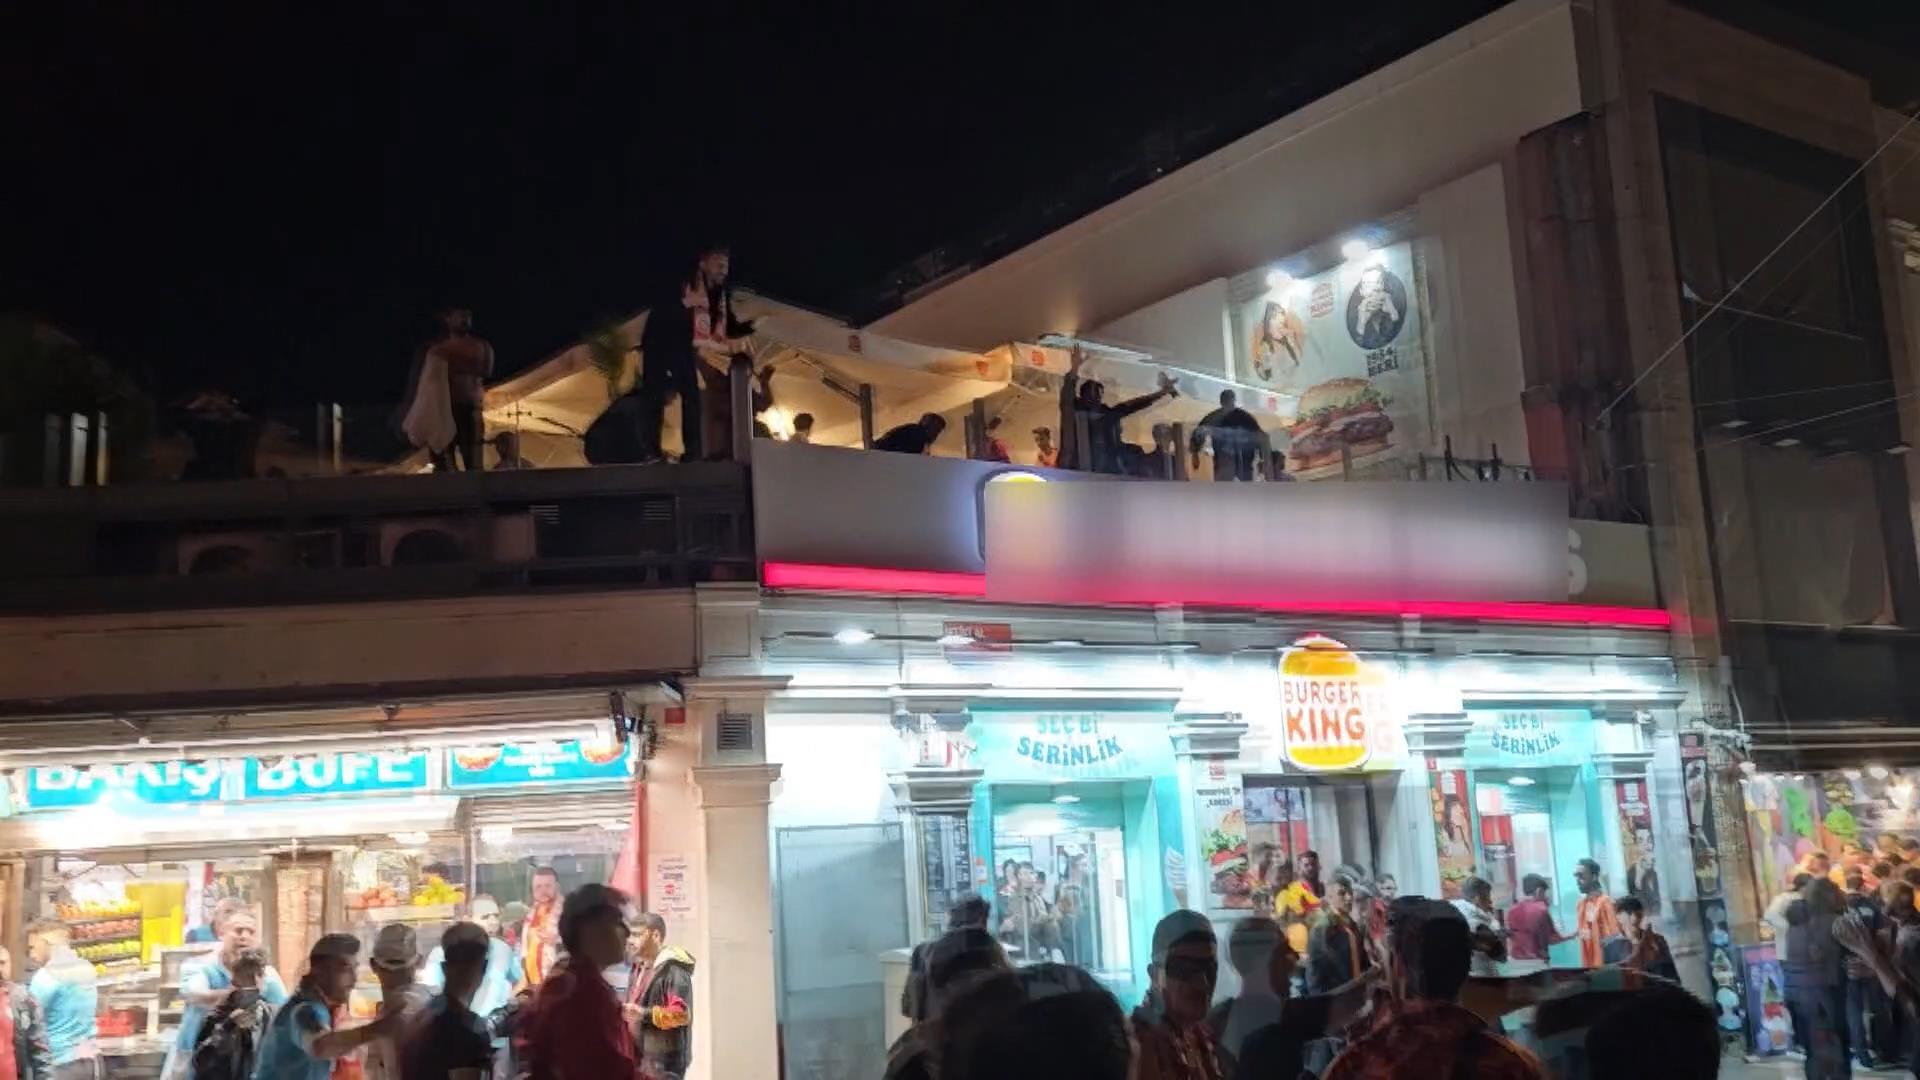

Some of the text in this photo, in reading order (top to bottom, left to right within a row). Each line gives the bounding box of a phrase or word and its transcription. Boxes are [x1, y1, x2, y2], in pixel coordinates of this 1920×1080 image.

[1283, 681, 1361, 704] BURGER
[1286, 707, 1365, 742] KING
[1017, 735, 1124, 766] SERİNLİK
